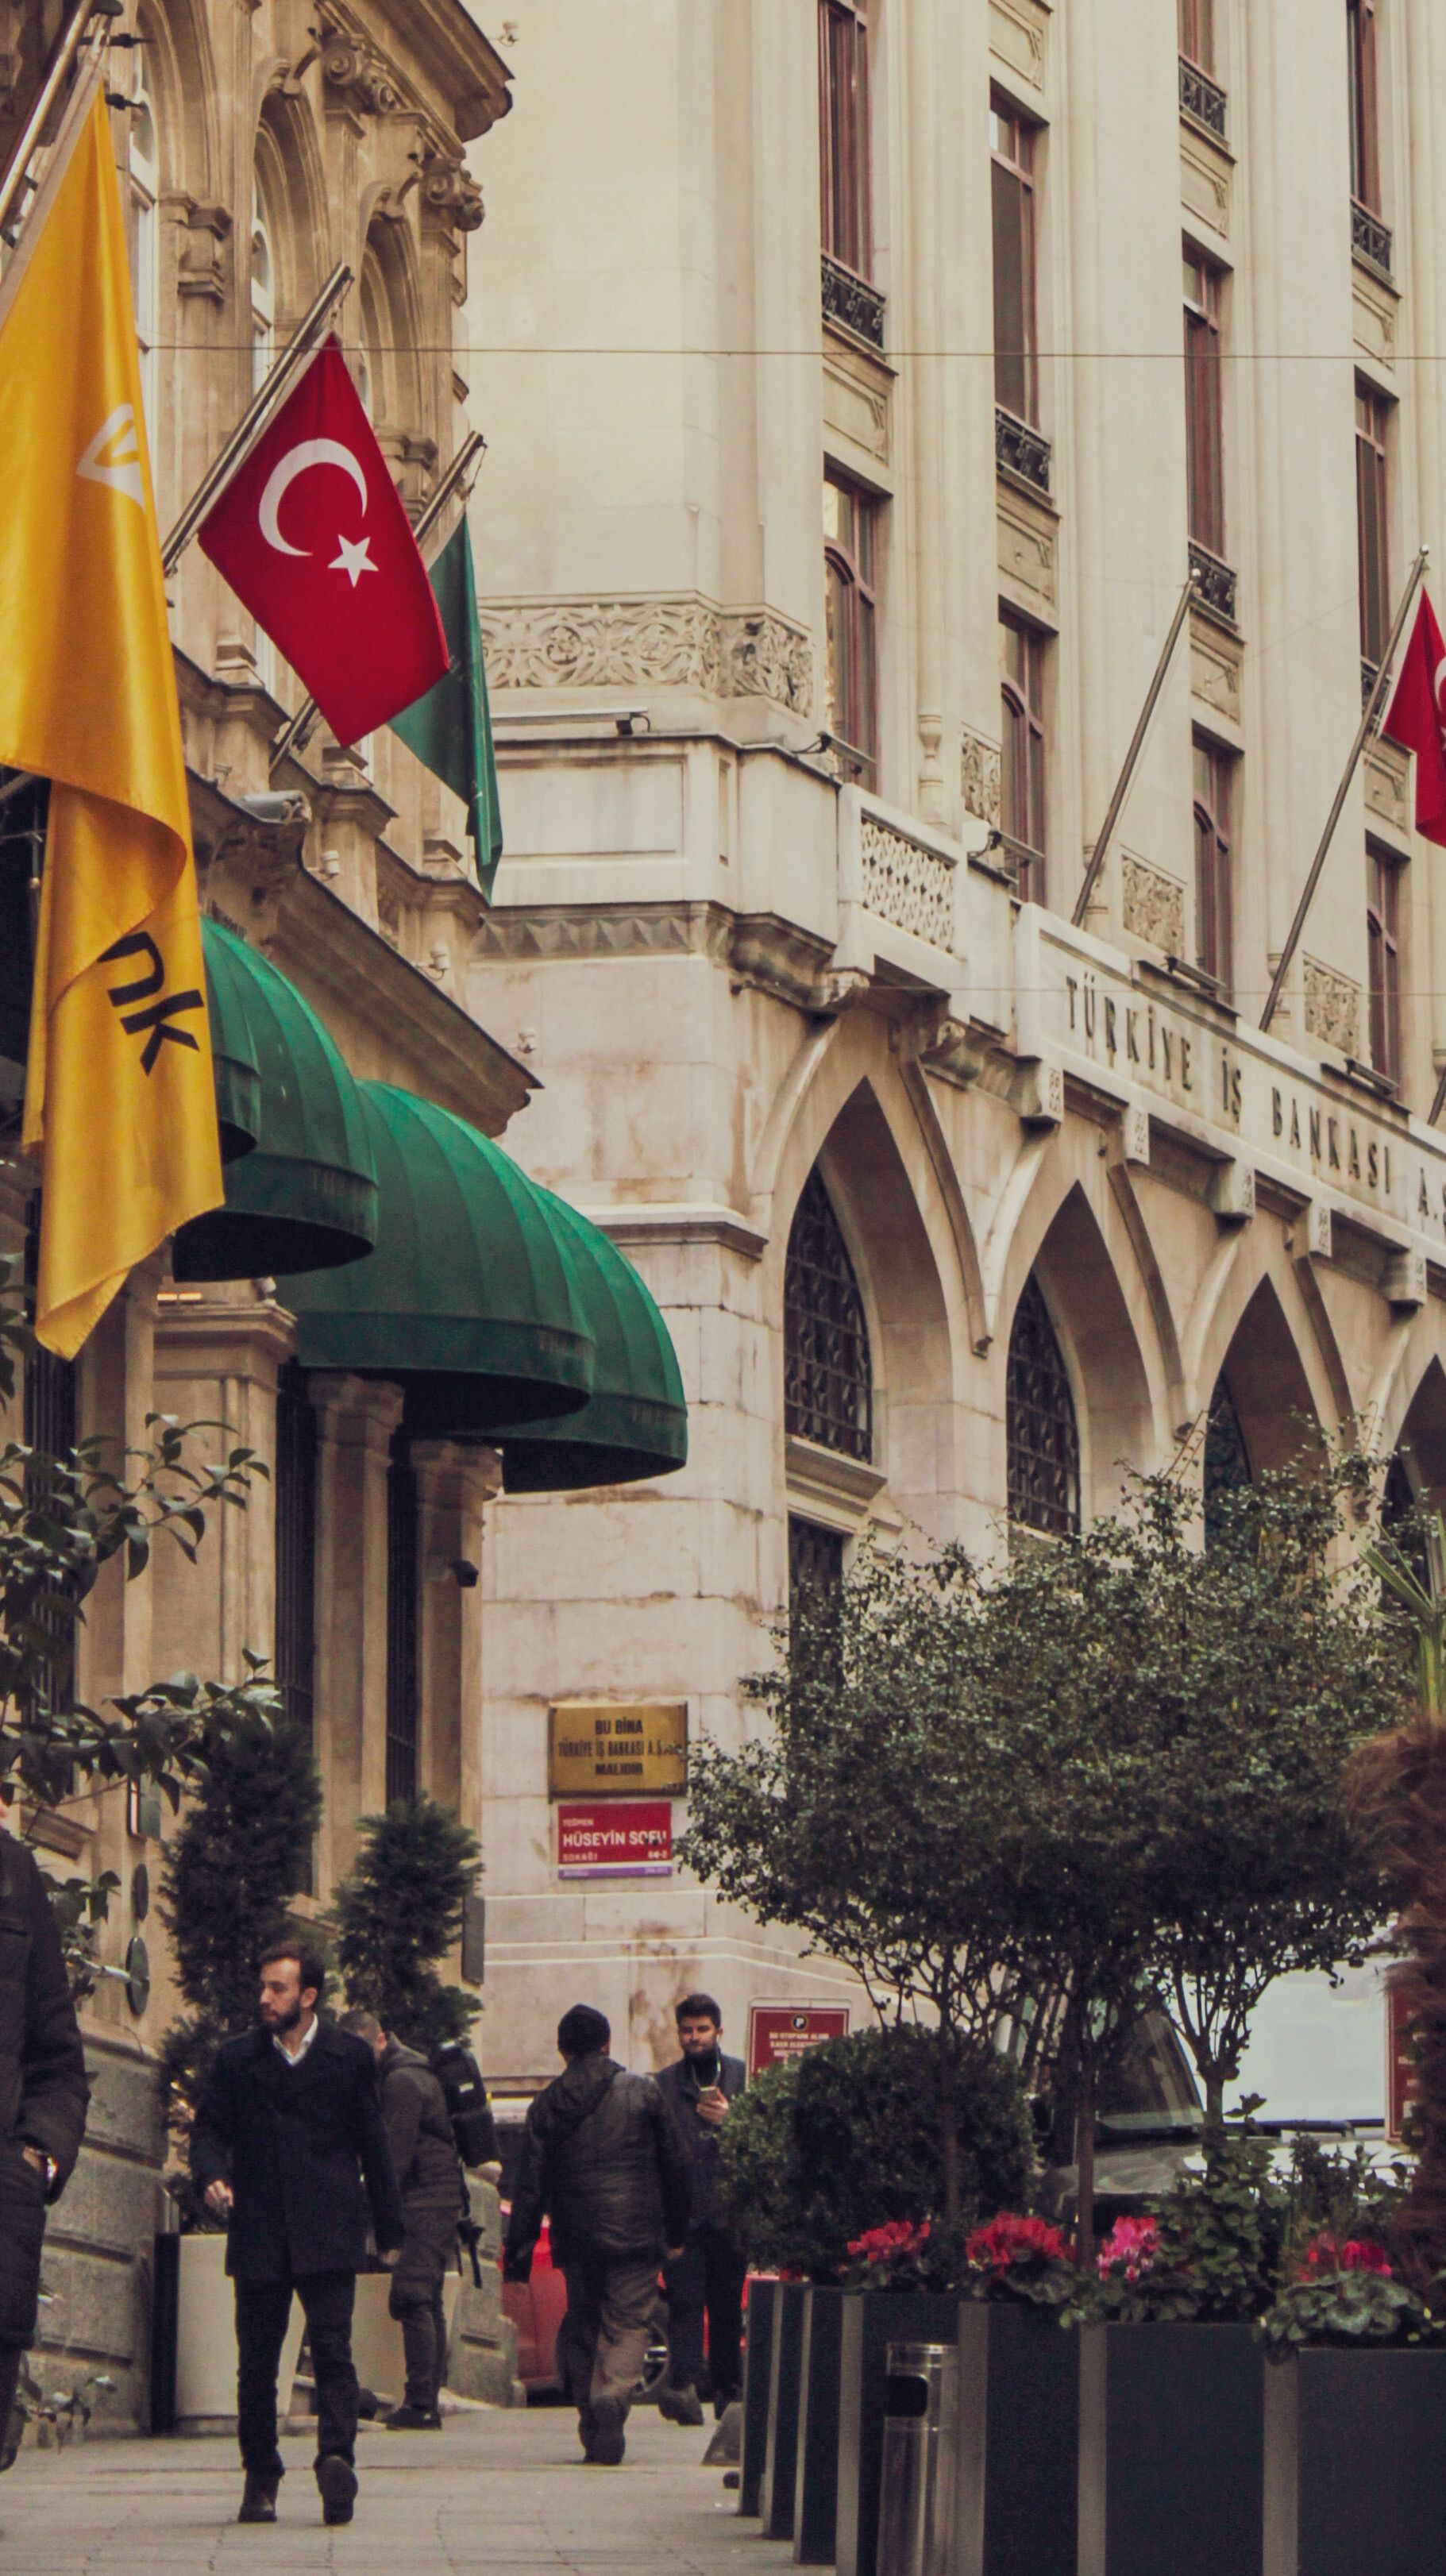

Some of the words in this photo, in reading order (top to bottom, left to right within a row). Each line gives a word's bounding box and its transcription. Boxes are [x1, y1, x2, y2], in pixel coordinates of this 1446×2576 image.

[1066, 971, 1192, 1090] TÜRKİYE
[1222, 1047, 1242, 1124] İŞ
[1272, 1087, 1390, 1194] BANKASI
[562, 1829, 626, 1848] HÜSEYİN
[796, 2017, 804, 2027] P
